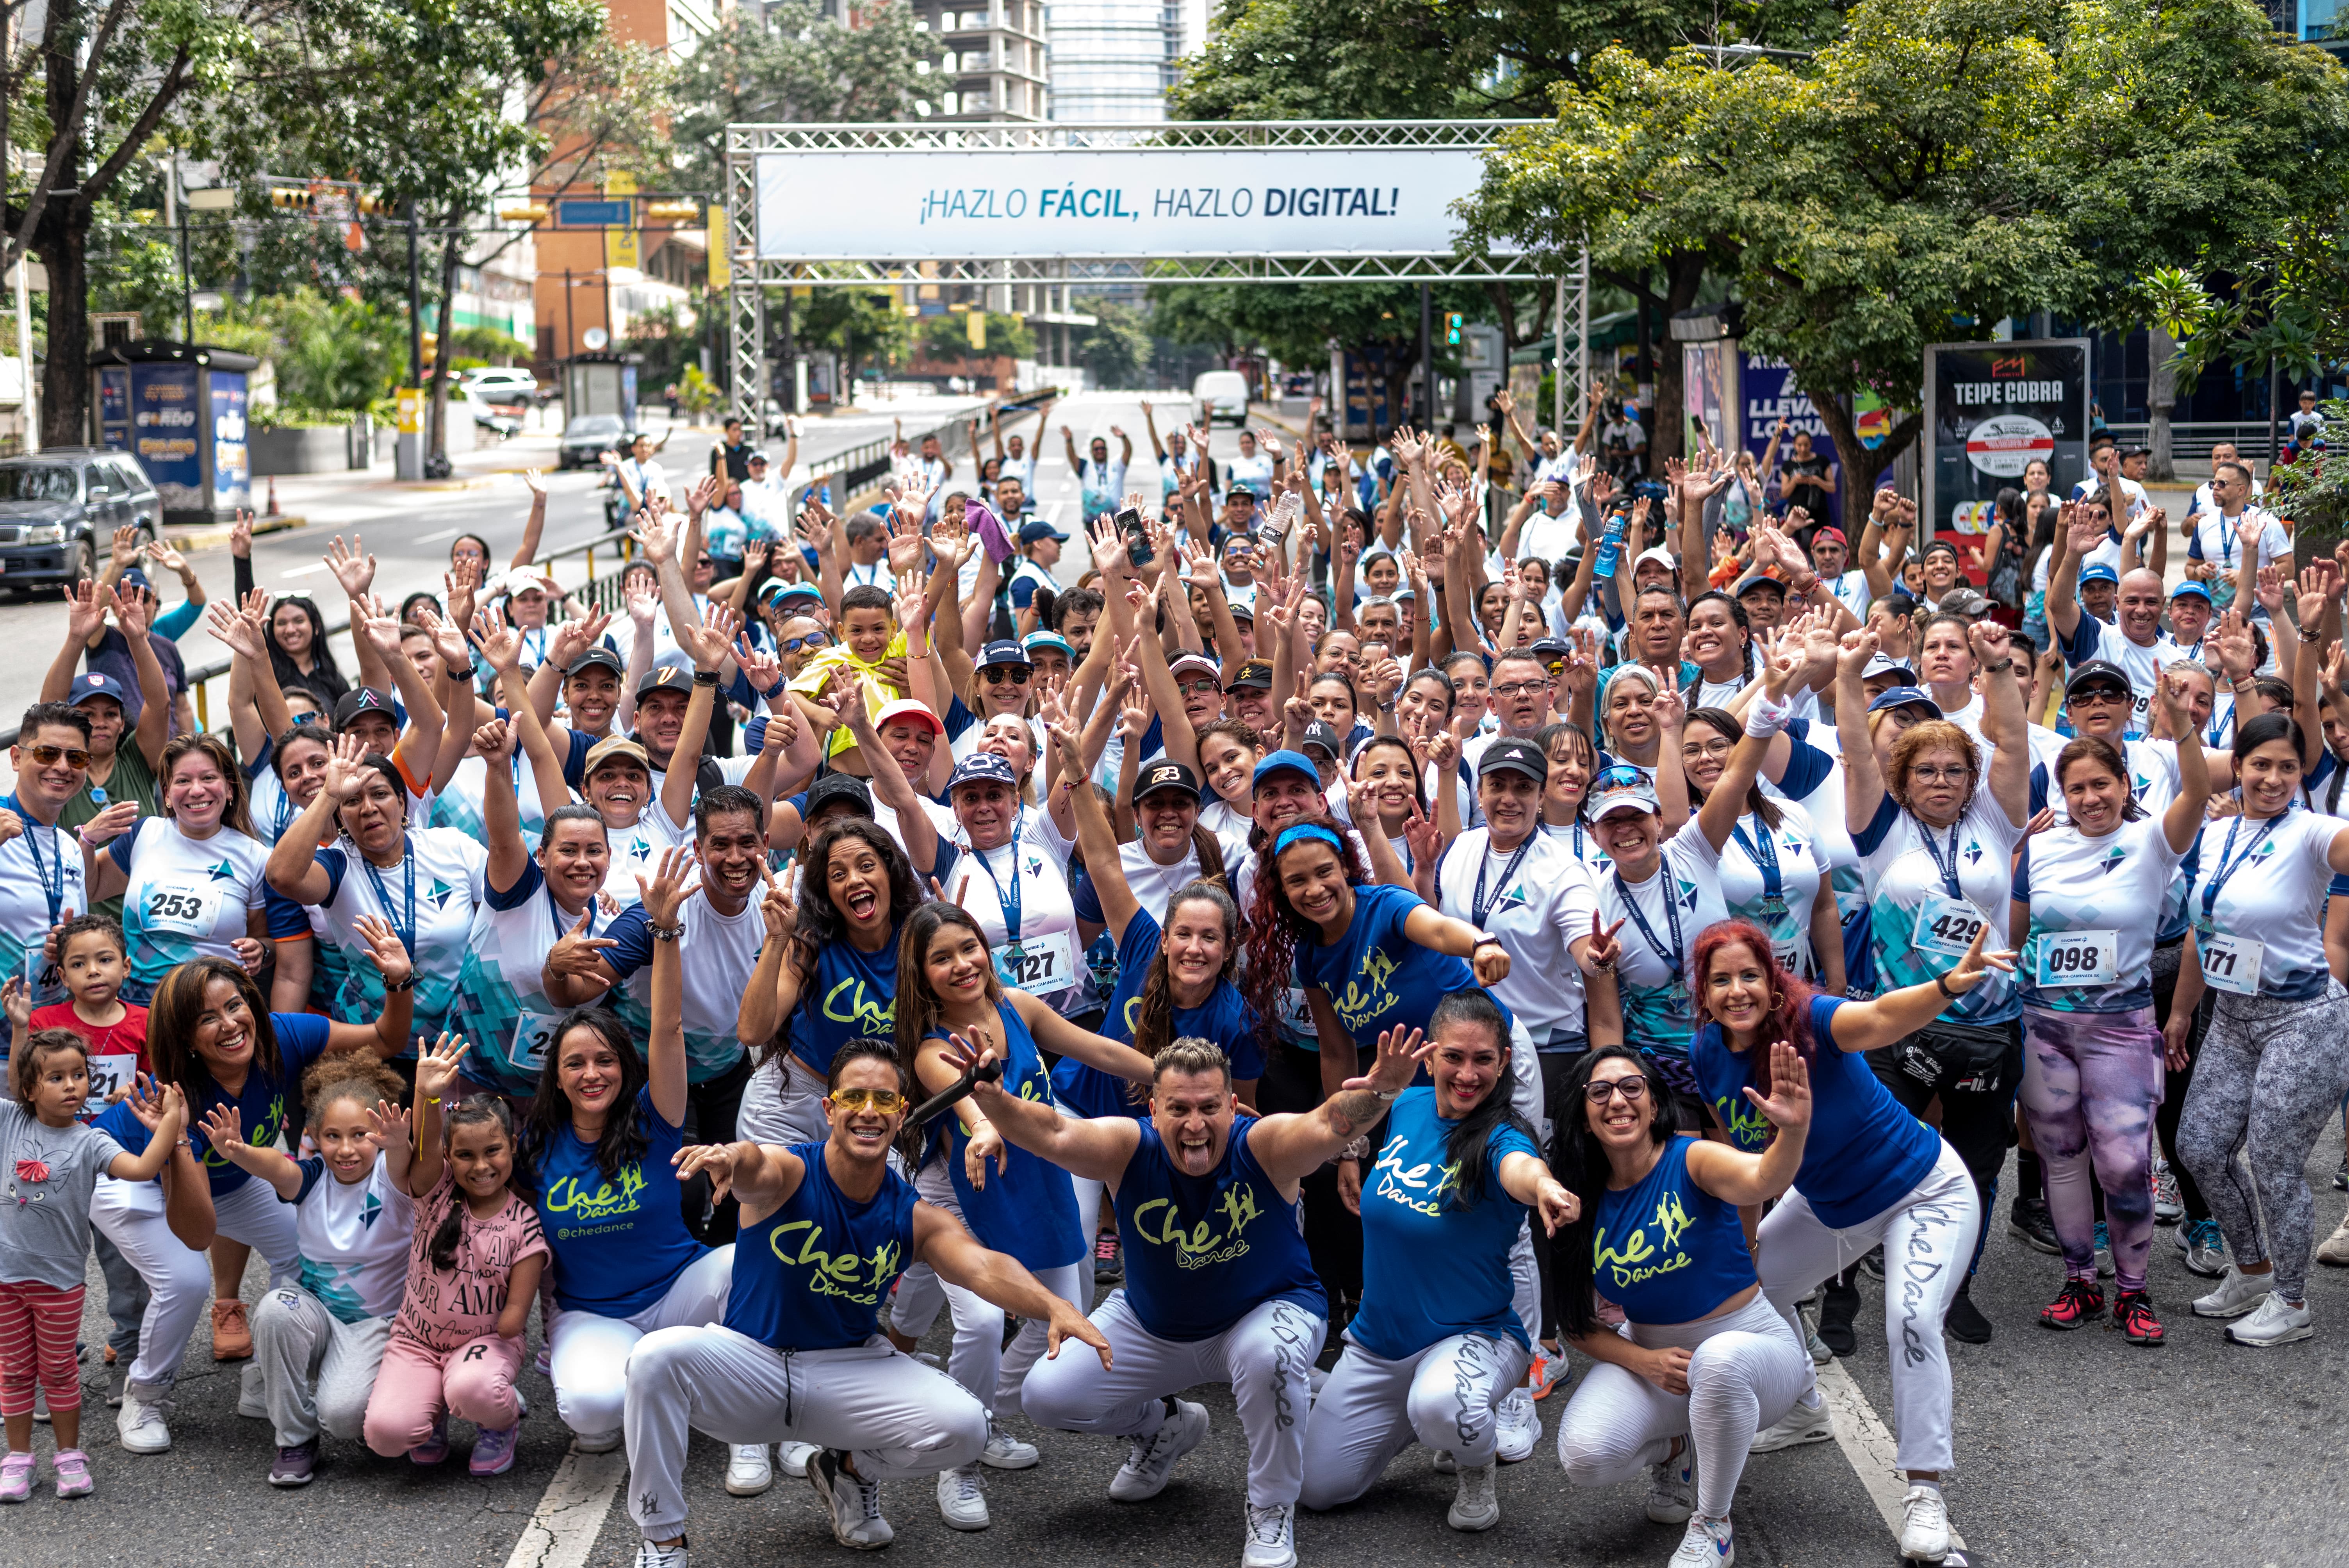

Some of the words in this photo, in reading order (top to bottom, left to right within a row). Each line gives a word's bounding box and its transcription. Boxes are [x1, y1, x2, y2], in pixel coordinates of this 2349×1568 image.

[919, 189, 1027, 225] ¡HAZLO
[1039, 181, 1140, 223] FÁCIL,
[1153, 187, 1254, 217] HAZLO
[1263, 186, 1400, 217] DIGITAL!
[1953, 381, 2001, 405] TEIPE
[2005, 380, 2063, 404] COBRA
[1748, 397, 1820, 419] LLEVA
[1124, 518, 1135, 526] 10:12
[1305, 721, 1322, 736] NY
[817, 780, 863, 798] BOSS
[1765, 838, 1775, 860] Aniversario
[2225, 827, 2236, 851] Aniversario
[2247, 831, 2265, 852] BANCARIBE
[1507, 850, 1523, 874] Aniversario
[2222, 860, 2240, 881] Aniversario
[1475, 881, 1483, 905] Aniversario
[1487, 884, 1502, 909] BANCARIBE
[1664, 877, 1673, 902] BANCARIBE
[148, 893, 202, 920] 253
[383, 901, 398, 927] BANCARIBE
[1624, 896, 1640, 919] Aniversario
[1949, 906, 1972, 914] BANCARIBE
[1671, 914, 1679, 940] Aniversario
[1929, 914, 1982, 944] 429
[1644, 929, 1662, 951] BANCARIBE
[1930, 939, 1970, 950] CARRERA-CAMINA
[2209, 938, 2230, 946] BANCARIBE
[1016, 950, 1055, 984] 127
[2049, 946, 2099, 972] 098
[2203, 947, 2238, 976] 171
[1019, 979, 1058, 992] ARRERA-CAMINATA
[2202, 972, 2233, 984] RRERA-CAMINATA
[1318, 981, 1370, 1016] he
[1341, 992, 1400, 1033] Dance
[1955, 1076, 1999, 1092] FILA
[546, 1176, 618, 1212] Che
[1377, 1172, 1441, 1217] Dance
[576, 1199, 641, 1220] Dance
[558, 1222, 634, 1240] @chedance
[1134, 1198, 1222, 1253] Che
[770, 1220, 861, 1281] Che
[1176, 1239, 1250, 1270] Dance
[1592, 1227, 1655, 1274] he
[1611, 1252, 1692, 1288] Dance
[809, 1269, 878, 1305] Dance
[463, 1345, 488, 1362] R
